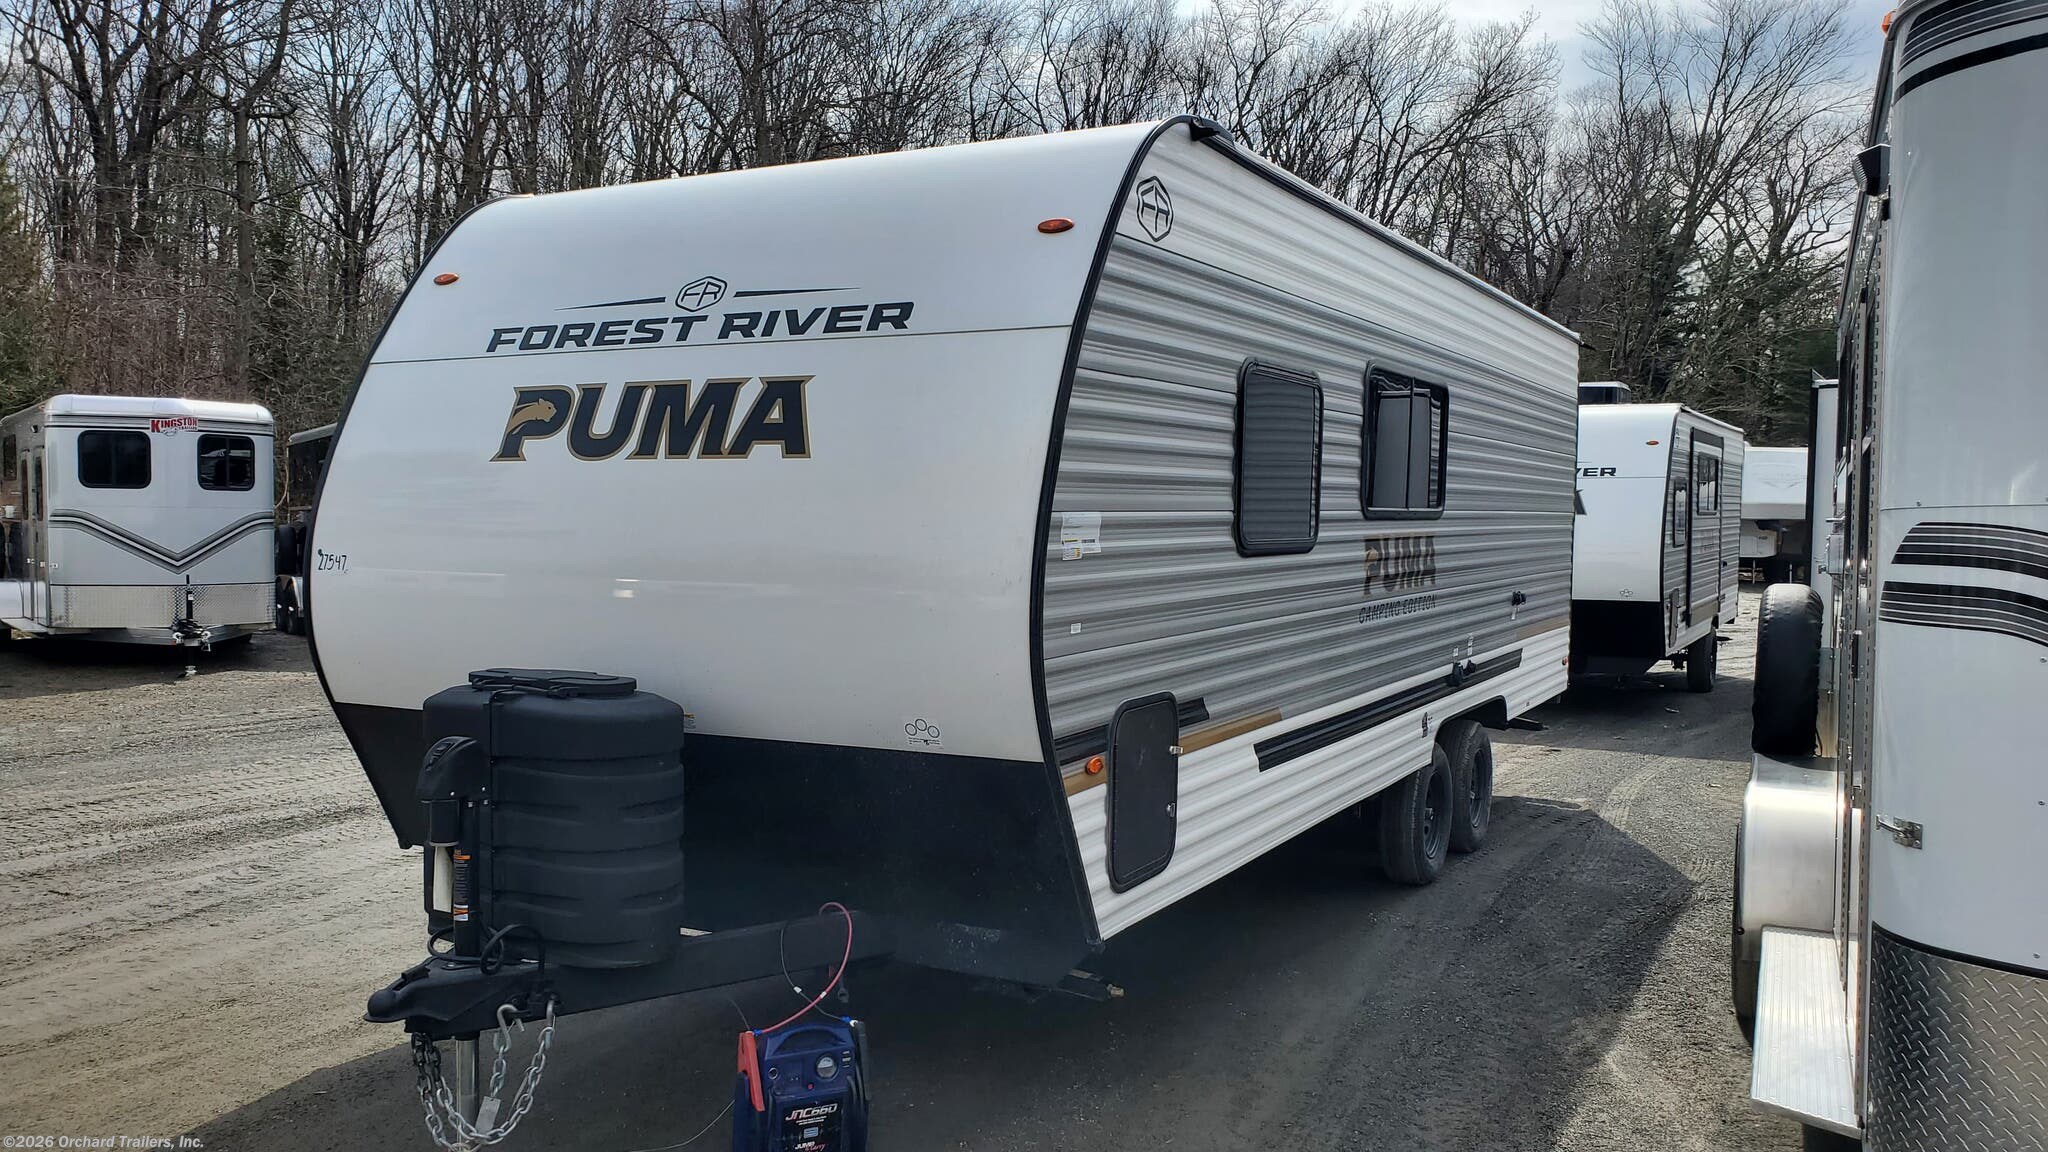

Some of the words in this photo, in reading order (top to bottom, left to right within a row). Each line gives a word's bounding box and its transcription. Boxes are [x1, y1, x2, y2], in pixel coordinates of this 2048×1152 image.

[485, 314, 709, 353] FOREST
[717, 300, 915, 341] RIVER
[150, 416, 198, 433] KINGSTON
[489, 374, 817, 463] PUMA
[317, 548, 347, 571] 27547
[1361, 532, 1437, 600] PUMA
[1358, 600, 1401, 624] CAMPING
[1402, 593, 1438, 615] EDITION
[784, 1103, 839, 1121] JNC660
